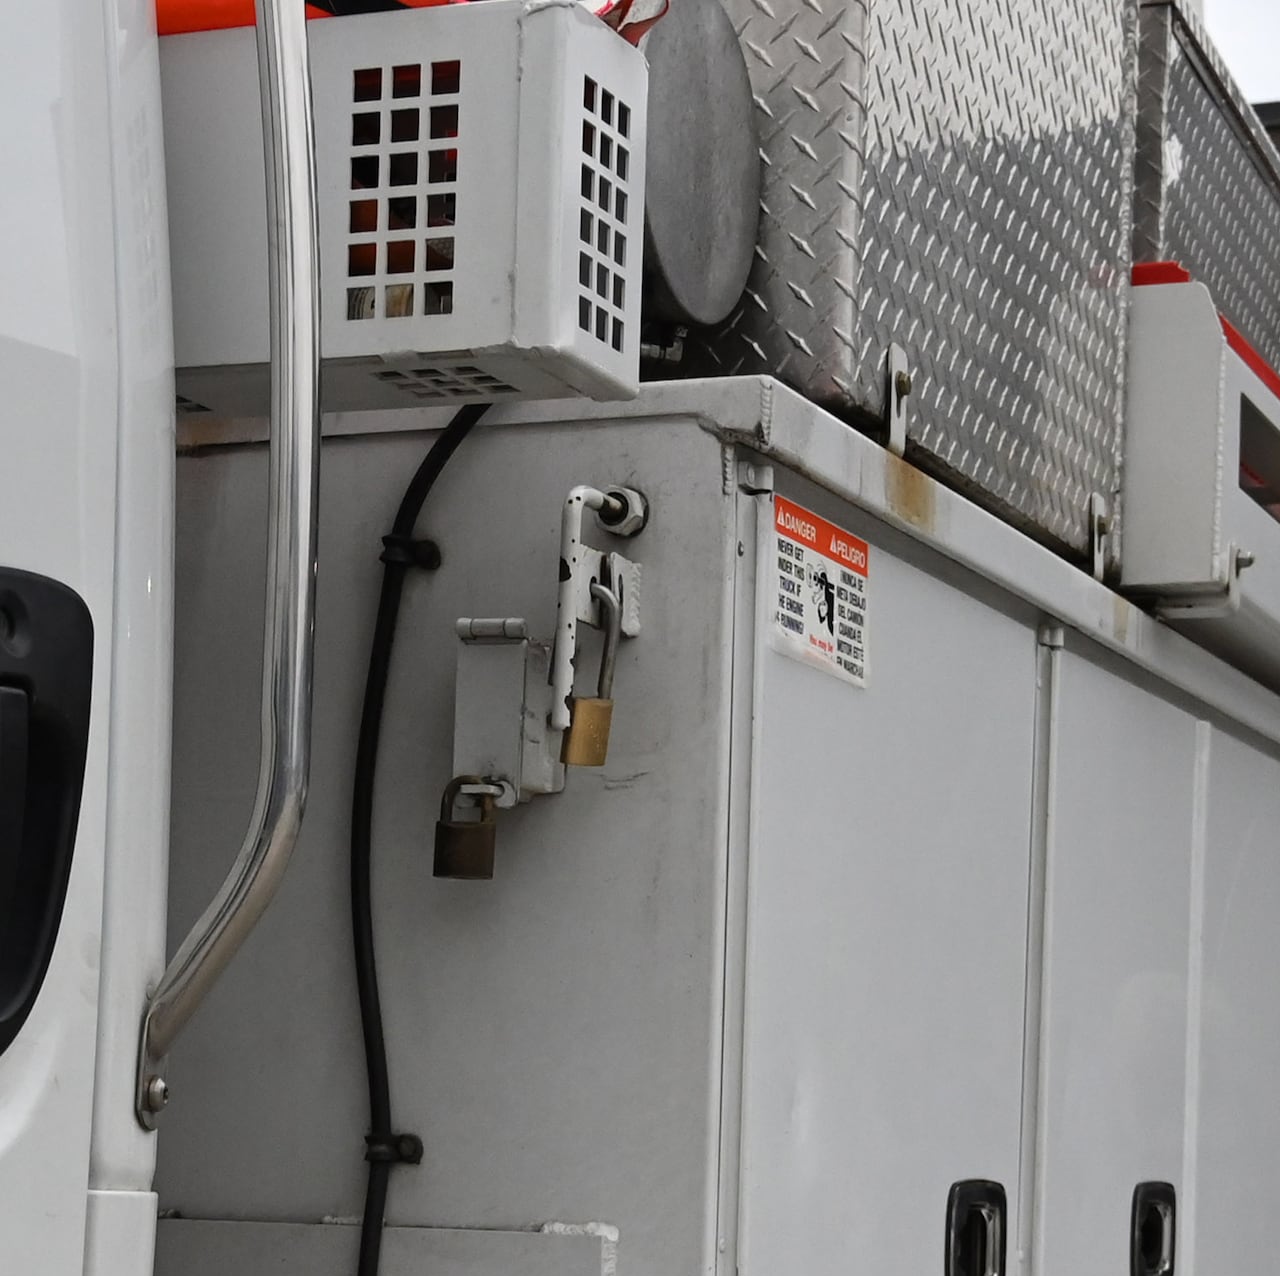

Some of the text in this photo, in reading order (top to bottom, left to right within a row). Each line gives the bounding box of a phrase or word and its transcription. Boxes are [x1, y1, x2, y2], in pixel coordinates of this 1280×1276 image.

[778, 538, 804, 562] NEVER GET
[785, 512, 866, 568] DANGER PELIGRO
[794, 564, 804, 581] THIS
[780, 576, 802, 597] TRUCK IF
[786, 597, 804, 618] ENGINE
[838, 604, 846, 619] DEL
